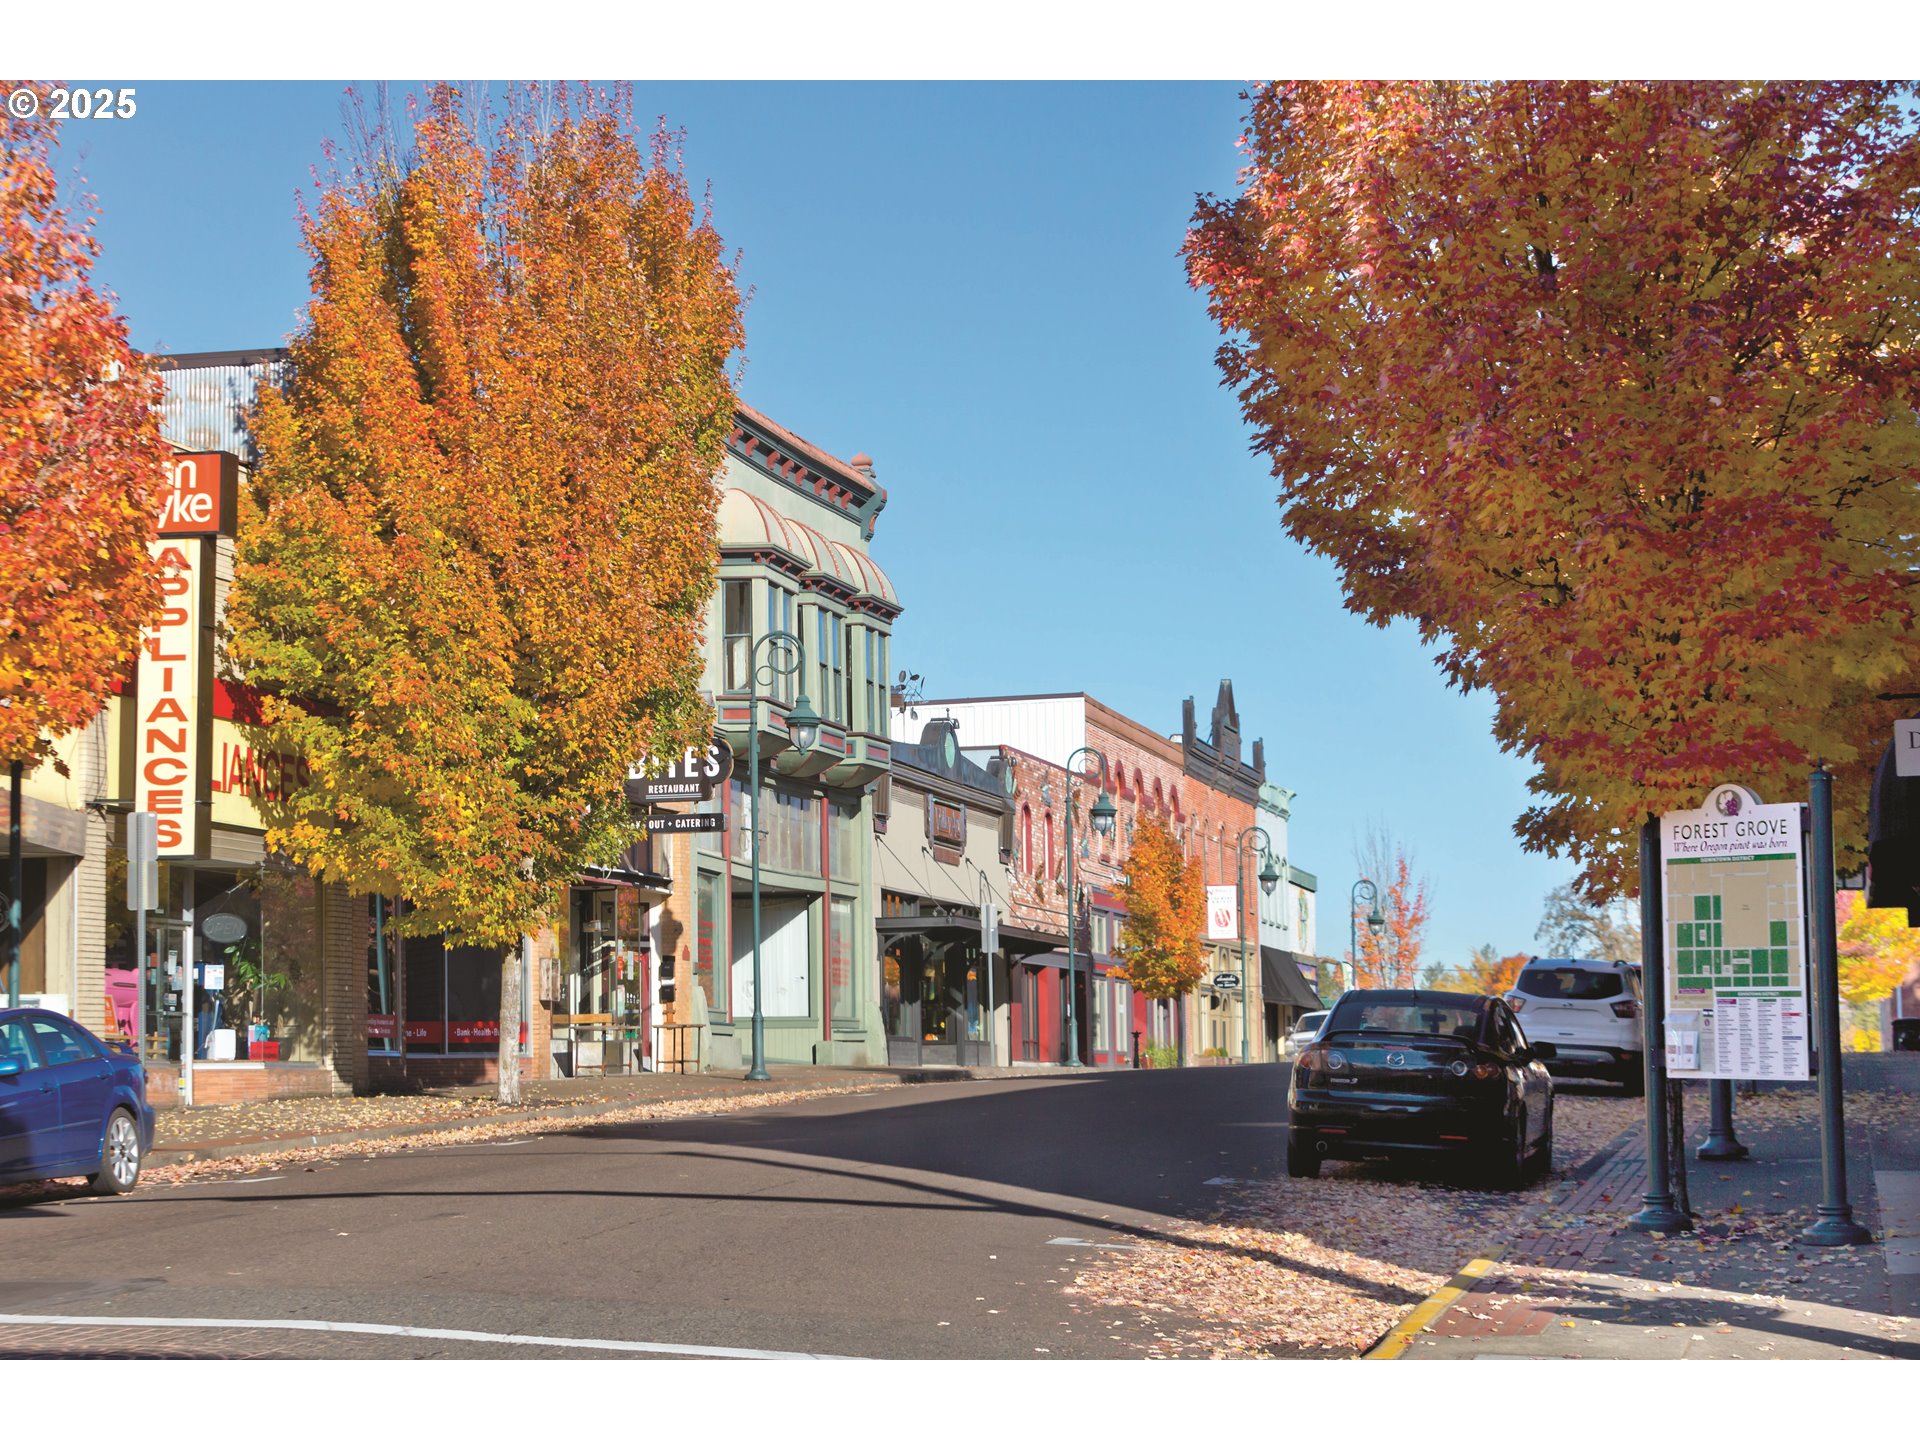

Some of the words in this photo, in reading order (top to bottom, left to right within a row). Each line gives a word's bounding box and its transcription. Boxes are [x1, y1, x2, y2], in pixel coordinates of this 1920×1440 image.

[648, 783, 700, 794] RESTAURANT
[648, 819, 665, 829] OUT
[675, 818, 716, 829] CATERING
[1673, 822, 1728, 840] FOREST
[1735, 819, 1787, 837] GROVE
[1673, 841, 1698, 853] Where
[1700, 840, 1728, 854] Oregon
[1729, 839, 1750, 853] pinot
[1752, 841, 1766, 849] was
[1769, 837, 1788, 848] born
[456, 1028, 471, 1037] Bank
[473, 1028, 492, 1037] Health
